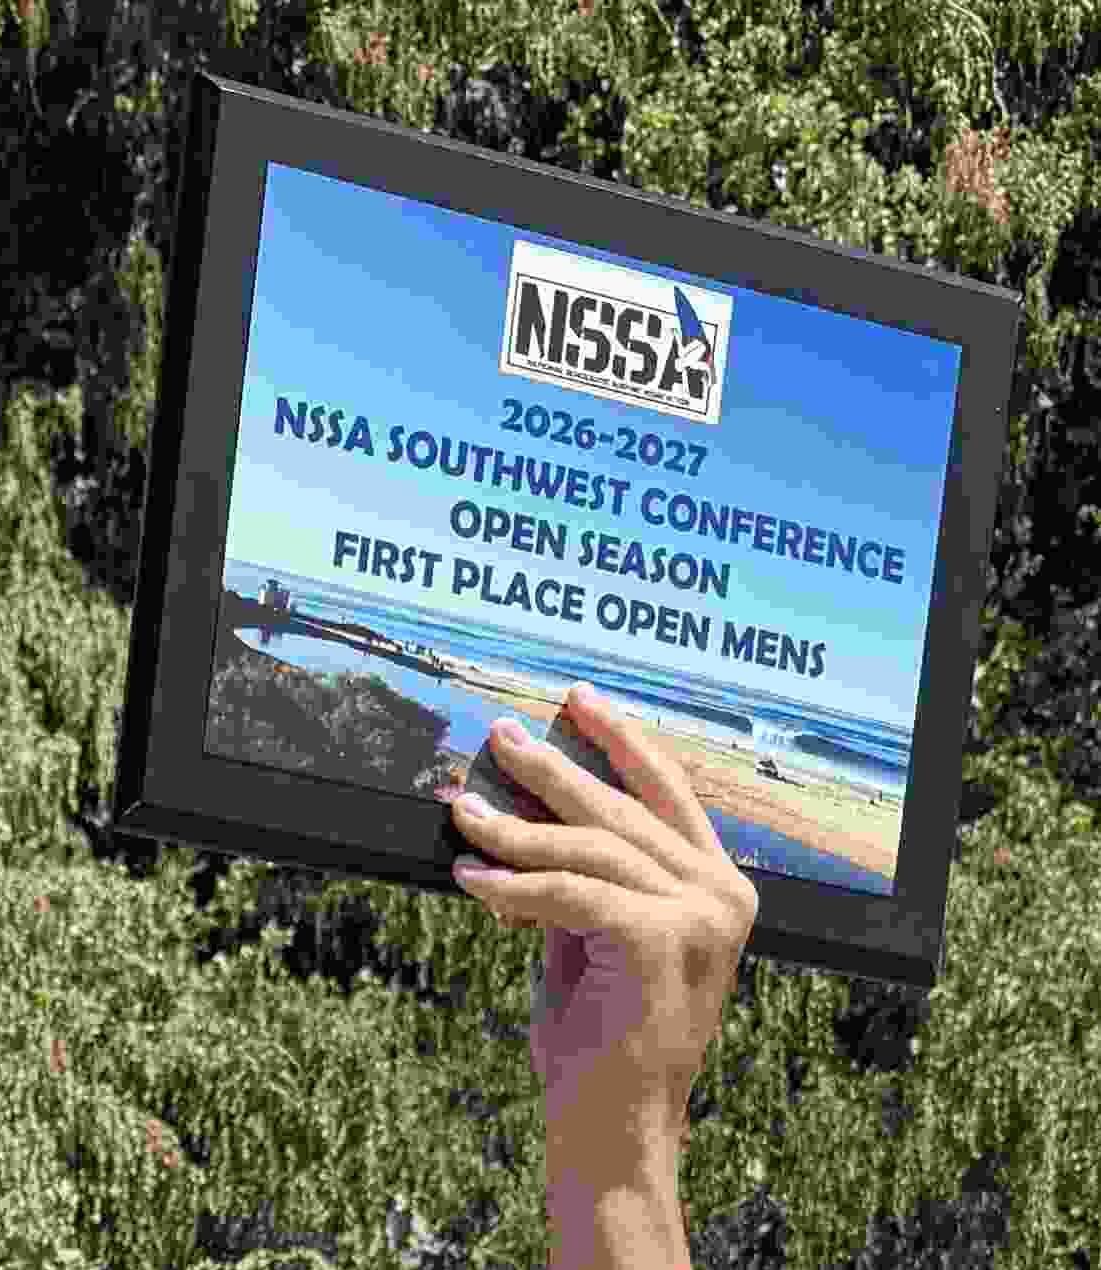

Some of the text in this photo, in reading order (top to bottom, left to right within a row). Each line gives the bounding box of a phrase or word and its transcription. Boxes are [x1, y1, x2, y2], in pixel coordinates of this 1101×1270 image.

[513, 281, 706, 400] NSSA
[273, 396, 906, 585] NSSA SOUTHWEST CONFERENCE
[500, 397, 708, 477] 2026-2027
[332, 530, 828, 679] FIRST PLACE OPEN MENS
[449, 499, 731, 600] OPEN SEASON
